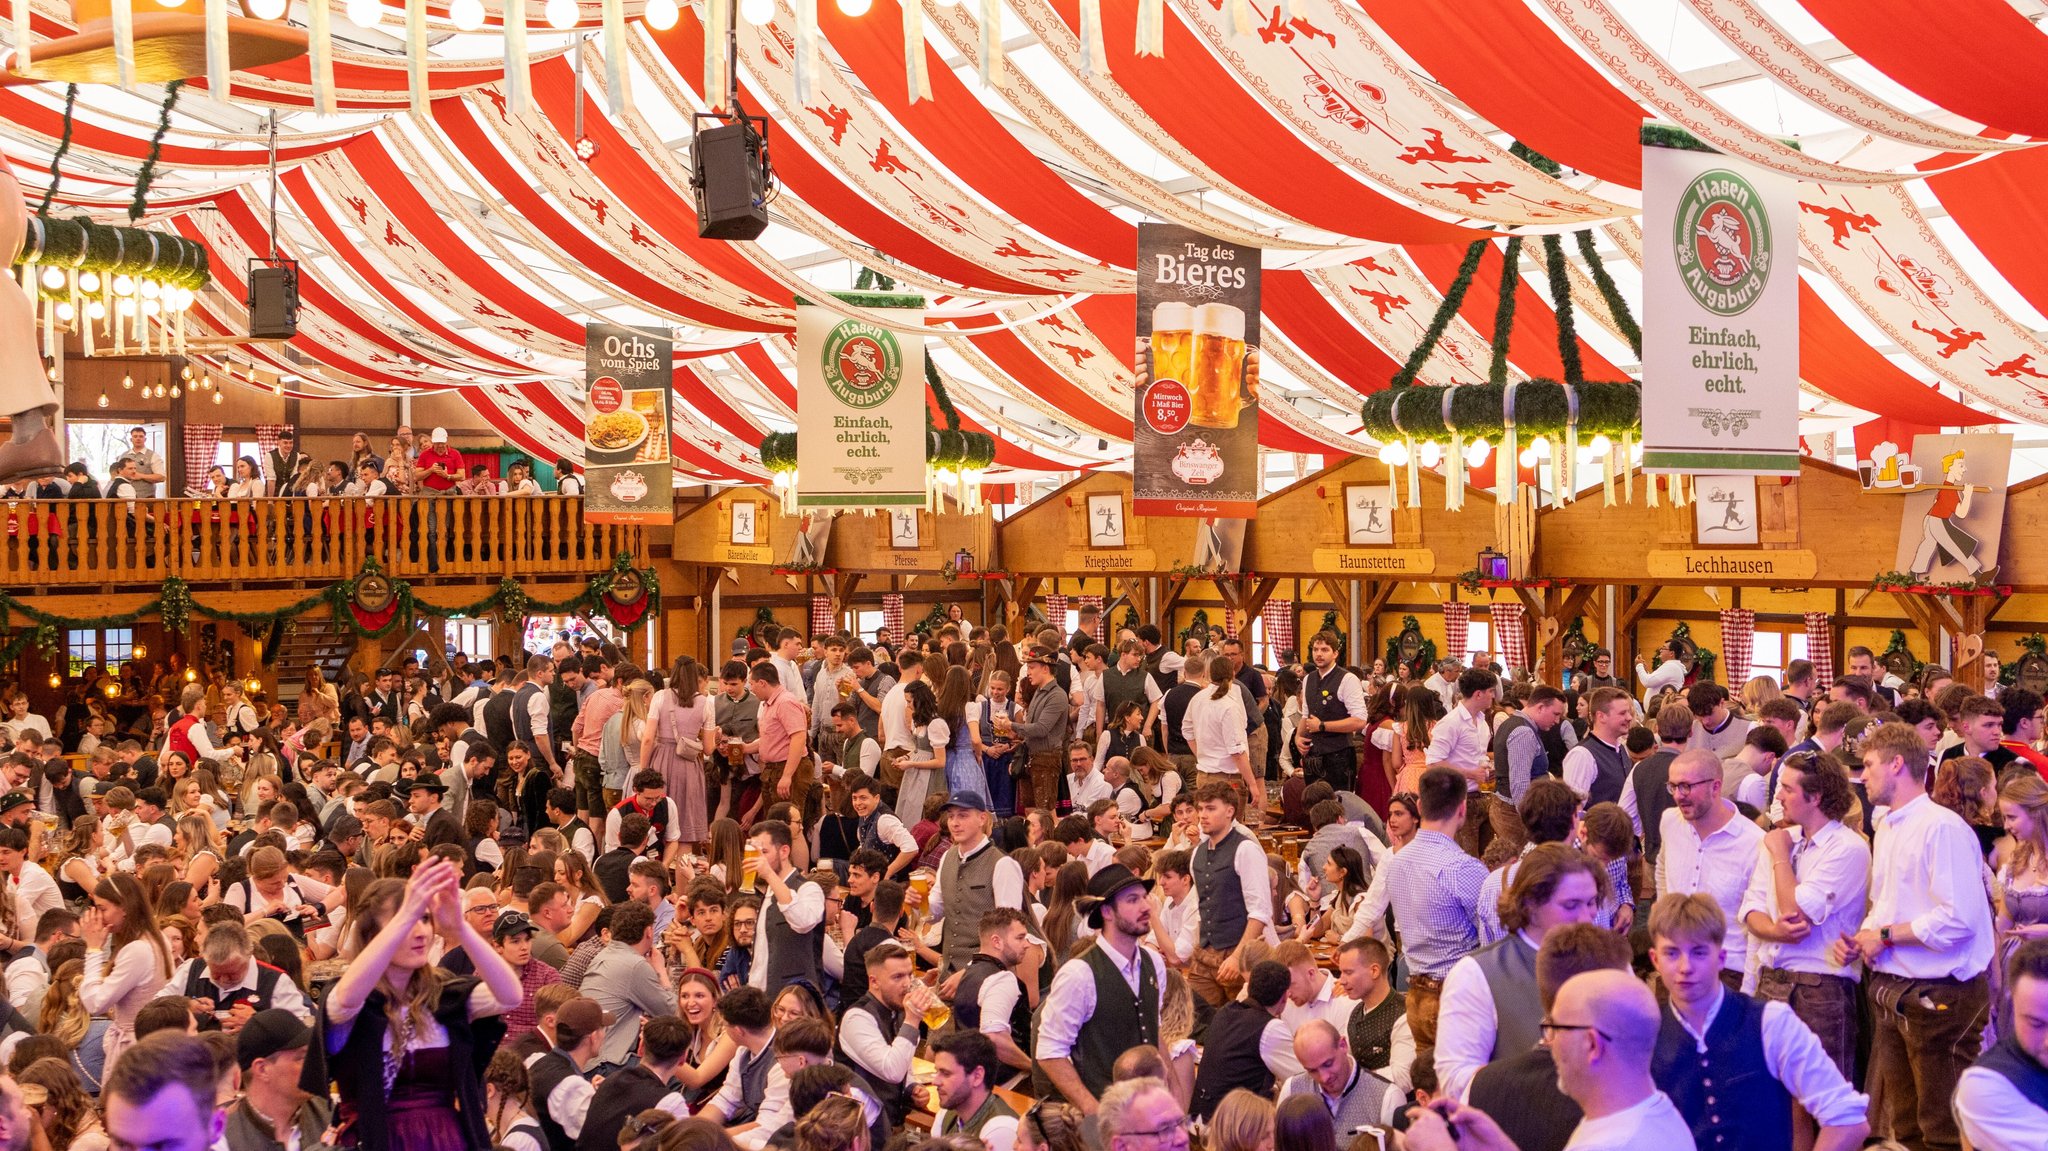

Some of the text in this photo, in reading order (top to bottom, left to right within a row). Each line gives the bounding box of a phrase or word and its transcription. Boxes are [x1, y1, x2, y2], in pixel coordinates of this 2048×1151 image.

[1695, 179, 1748, 206] Hasen
[1184, 243, 1234, 262] Tag des
[1155, 254, 1246, 289] Bieres
[1686, 267, 1761, 309] Augsburg
[839, 322, 884, 339] Hasen
[1688, 326, 1760, 350] Einfach,
[604, 336, 655, 358] Ochs
[600, 358, 660, 372] vom Spieß
[1692, 350, 1758, 374] ehrlich,
[832, 380, 893, 404] Augsburg
[1705, 374, 1746, 394] echt.
[834, 416, 892, 430] Einfach,
[836, 431, 890, 444] ehrlich,
[846, 446, 880, 457] echt.
[1180, 461, 1218, 470] Binswanger
[728, 550, 758, 560] Bärenkeller
[894, 554, 918, 566] Pfersee
[1084, 554, 1132, 570] Kriegshaber
[1340, 554, 1405, 568] Haunstetten
[1686, 556, 1774, 573] Lechhausen
